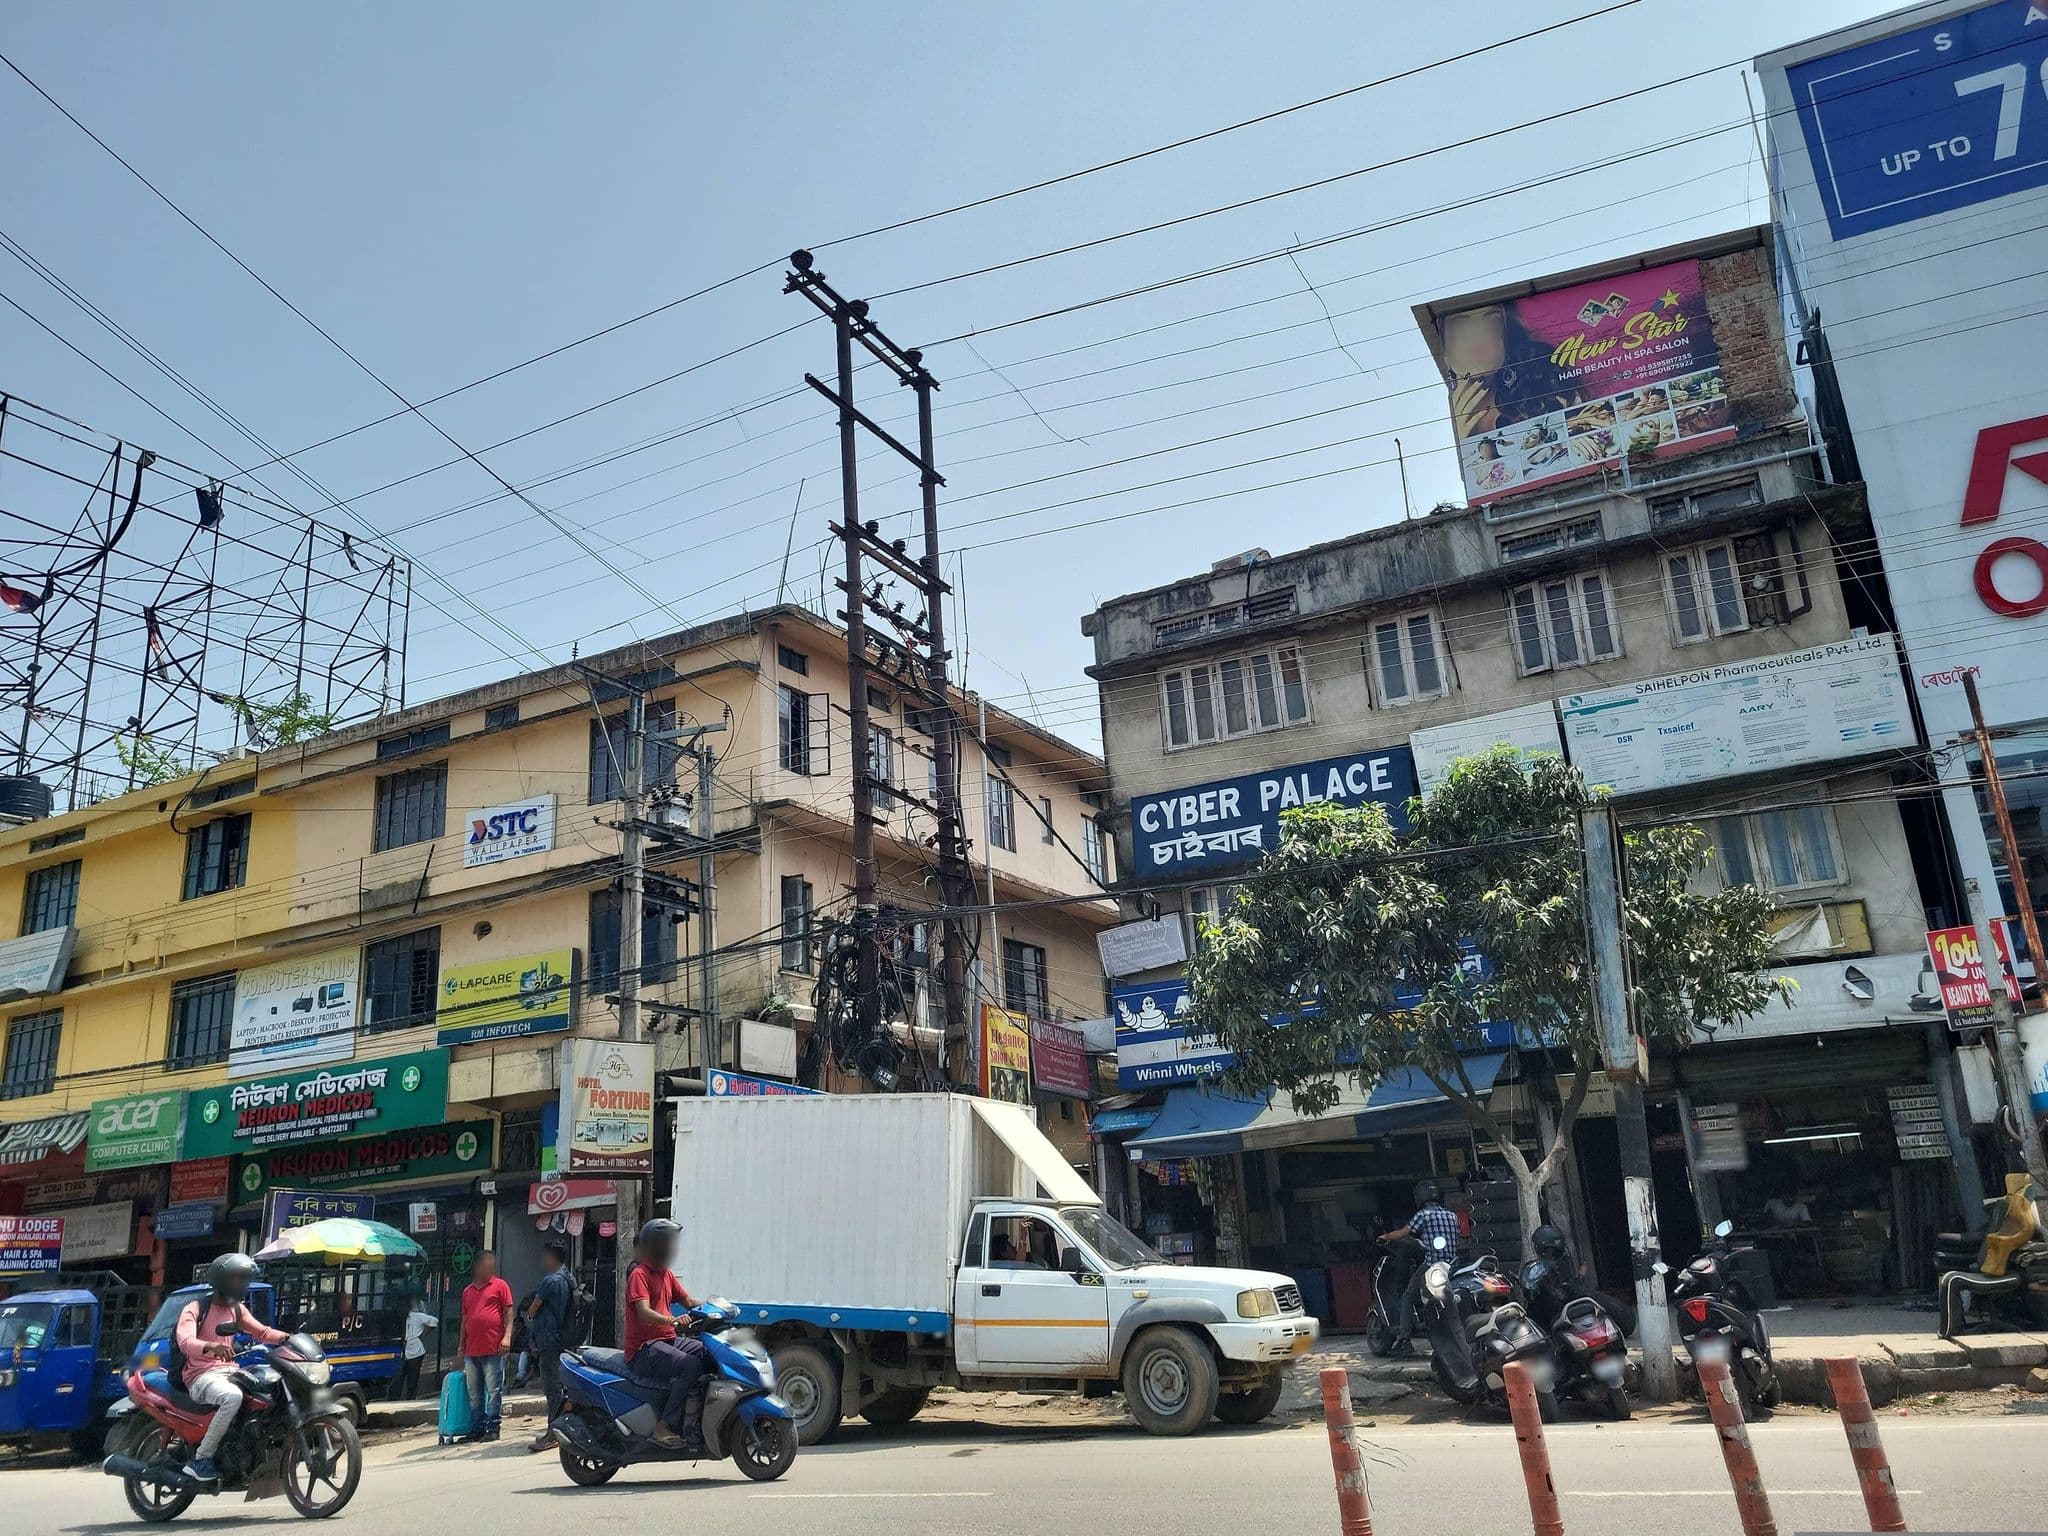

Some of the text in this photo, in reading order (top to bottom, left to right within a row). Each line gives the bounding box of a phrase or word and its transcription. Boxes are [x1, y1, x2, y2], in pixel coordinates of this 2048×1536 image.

[1880, 136, 1971, 175] UP TO
[1550, 311, 1688, 368] New Star
[1558, 337, 1690, 381] HAIR BEAUTY N SPA SALON
[1635, 671, 1710, 694] SAIHELPON
[1825, 645, 1854, 658] Pvt.
[1857, 636, 1886, 651] Ltd.
[1739, 702, 1774, 715] AARY
[1617, 735, 1633, 744] DSR
[1139, 756, 1393, 833] CYBER PALACE
[487, 807, 537, 841] STC
[471, 834, 539, 856] WALLPAPER
[460, 971, 514, 990] LAPCARE
[1946, 983, 1974, 1007] BEAUTY
[1973, 982, 1991, 1003] SPA
[236, 1009, 351, 1038] LAPTOP MACBOOK DESKTOP PROJECTOR
[244, 1022, 340, 1046] PRINTER DATA RECOVERY SERVER
[471, 1022, 531, 1039] RM INFOTECH
[1136, 1060, 1222, 1081] Winni Wheels
[578, 1077, 601, 1089] HOTEL
[238, 1104, 299, 1127] NEURON
[304, 1090, 373, 1119] MEDICOS
[589, 1090, 650, 1111] FORTUNE
[97, 1097, 171, 1134] acer
[339, 1109, 364, 1121] AVAILABLE
[252, 1135, 266, 1145] HOME
[267, 1131, 288, 1143] DELIVERY
[289, 1127, 314, 1140] AVAILABLE
[93, 1140, 170, 1159] COMPUTER CLINIC
[268, 1133, 449, 1178] NEURON MEDICOS
[19, 1219, 58, 1232] LODGE
[17, 1232, 46, 1241] AVAILABLE
[47, 1232, 61, 1240] HERE
[4, 1249, 21, 1259] HAIR
[29, 1249, 42, 1258] SPA
[30, 1259, 58, 1269] CENTRE
[1082, 1275, 1100, 1285] EX
